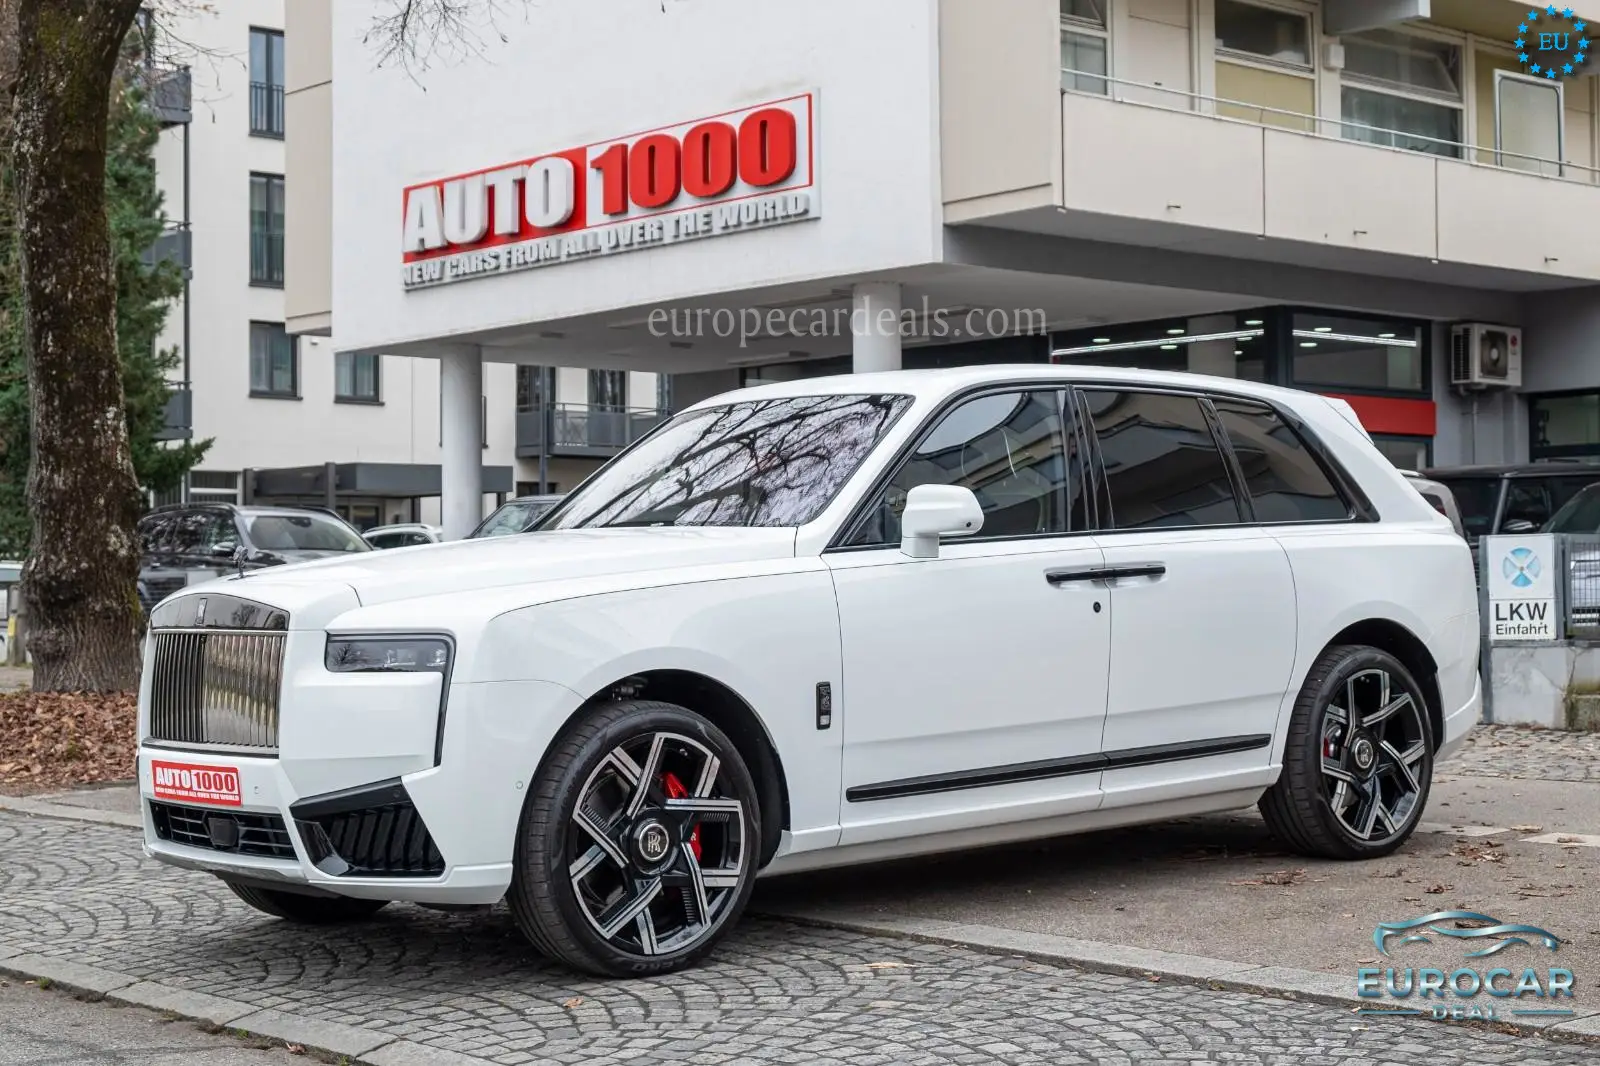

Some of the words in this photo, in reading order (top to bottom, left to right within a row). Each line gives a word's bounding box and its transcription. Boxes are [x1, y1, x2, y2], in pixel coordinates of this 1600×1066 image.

[403, 156, 576, 254] AUTO
[590, 107, 796, 215] 1000
[402, 260, 445, 286] NEW
[448, 250, 499, 277] CARS
[501, 242, 561, 271] FROM
[561, 232, 601, 257] ALL
[603, 220, 663, 249] OVER
[666, 210, 713, 238] THE
[714, 194, 810, 231] WORLD
[1495, 602, 1547, 621] LKW
[1495, 623, 1548, 635] Einfahrt
[155, 767, 191, 789] AUTO
[193, 772, 236, 792] 1000
